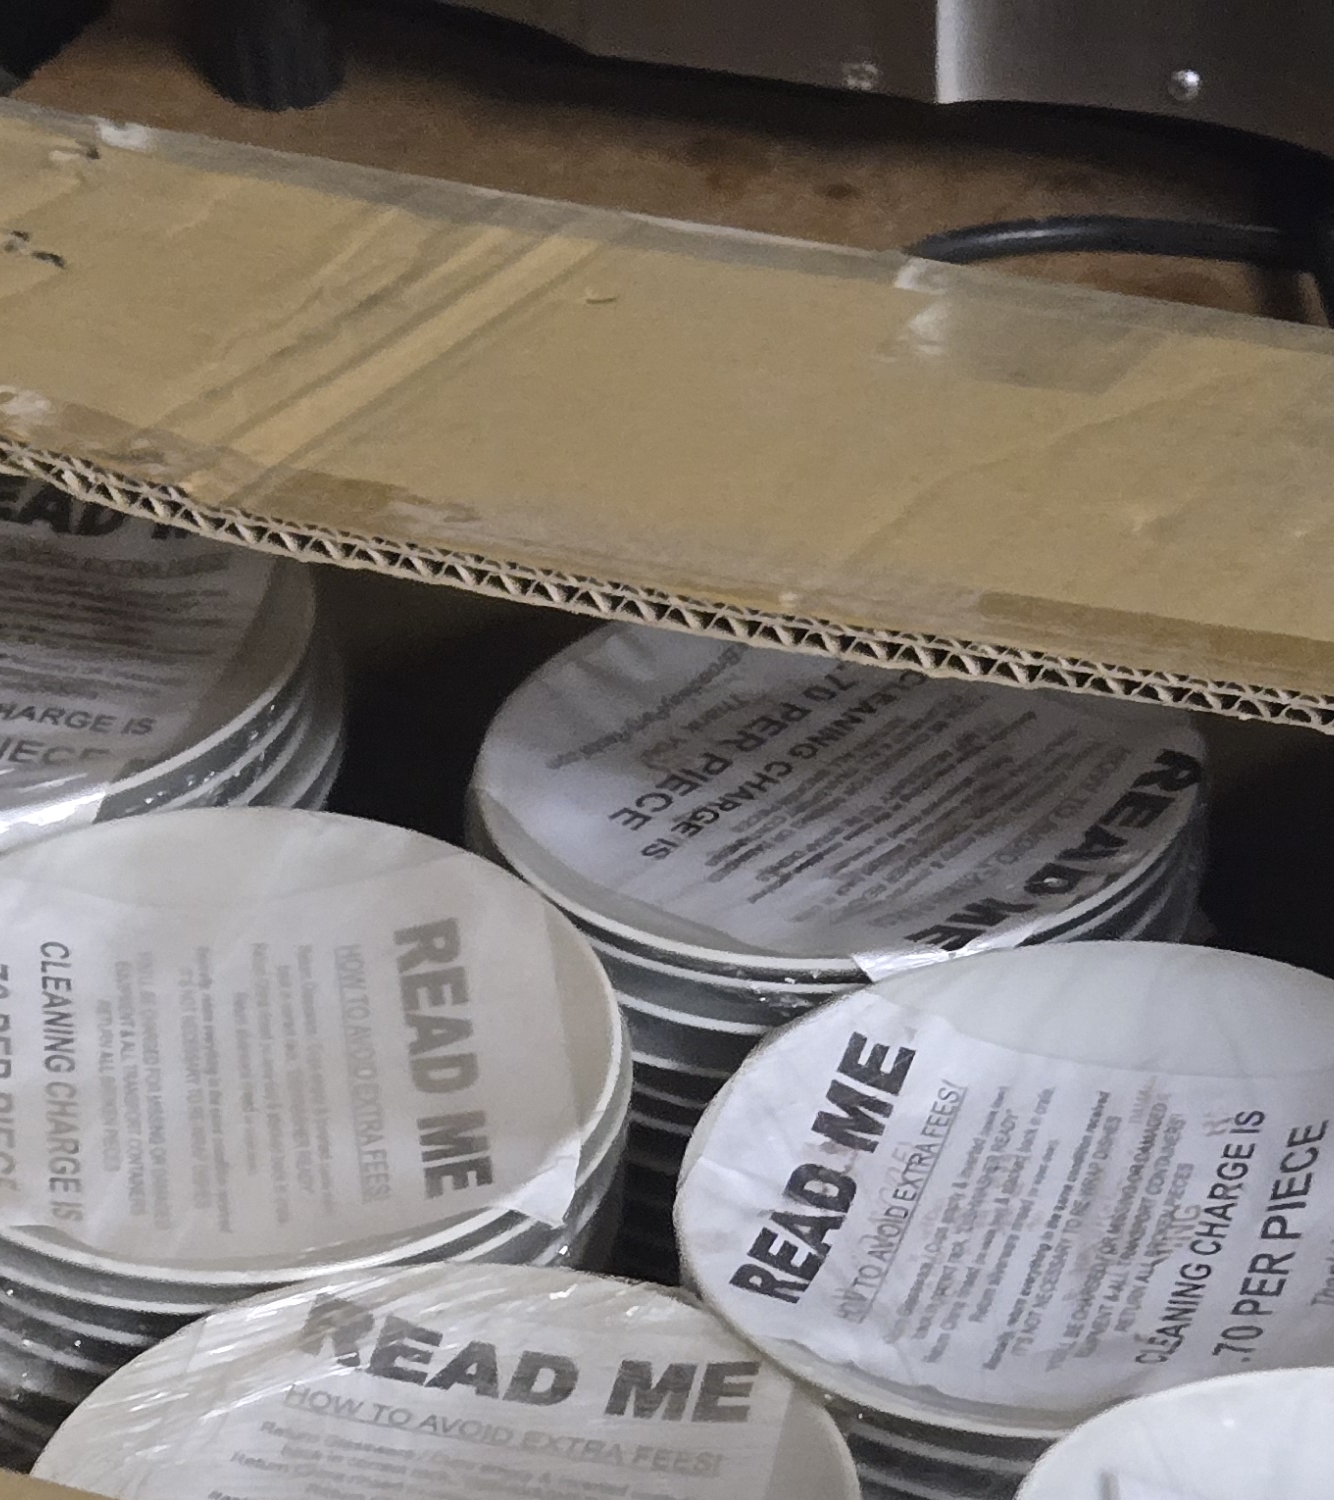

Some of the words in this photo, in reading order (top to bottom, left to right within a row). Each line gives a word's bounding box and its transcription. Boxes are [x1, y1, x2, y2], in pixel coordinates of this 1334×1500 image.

[120, 716, 158, 737] IS
[718, 702, 813, 752] PER
[789, 671, 930, 759] CLEANING
[601, 752, 737, 831] PIECE
[670, 760, 793, 837] CHARGE
[1023, 749, 1202, 895] READ
[636, 837, 682, 861] IS
[40, 941, 74, 1072] CLEANING
[344, 994, 369, 1020] TO
[394, 916, 481, 1094] READ
[45, 1081, 81, 1192] CHARGE
[919, 1078, 970, 1138] FEES!
[417, 1109, 493, 1199] ME
[729, 1162, 857, 1304] READ
[811, 1031, 917, 1154] ME
[890, 1140, 942, 1201] EXTRA
[1257, 1115, 1330, 1243] PIECE
[49, 1201, 83, 1222] IS
[863, 1204, 912, 1262] AVOID
[1131, 1260, 1214, 1368] CLEANING
[1185, 1139, 1258, 1257] CHARGE
[1230, 1108, 1268, 1136] IS
[848, 1262, 886, 1289] TO
[1228, 1246, 1296, 1320] PER
[300, 1293, 578, 1407] READ
[604, 1359, 761, 1423] ME
[1209, 1320, 1265, 1363] .70
[282, 1383, 364, 1417] HOW
[368, 1402, 414, 1428] TO
[417, 1412, 517, 1448] AVOID
